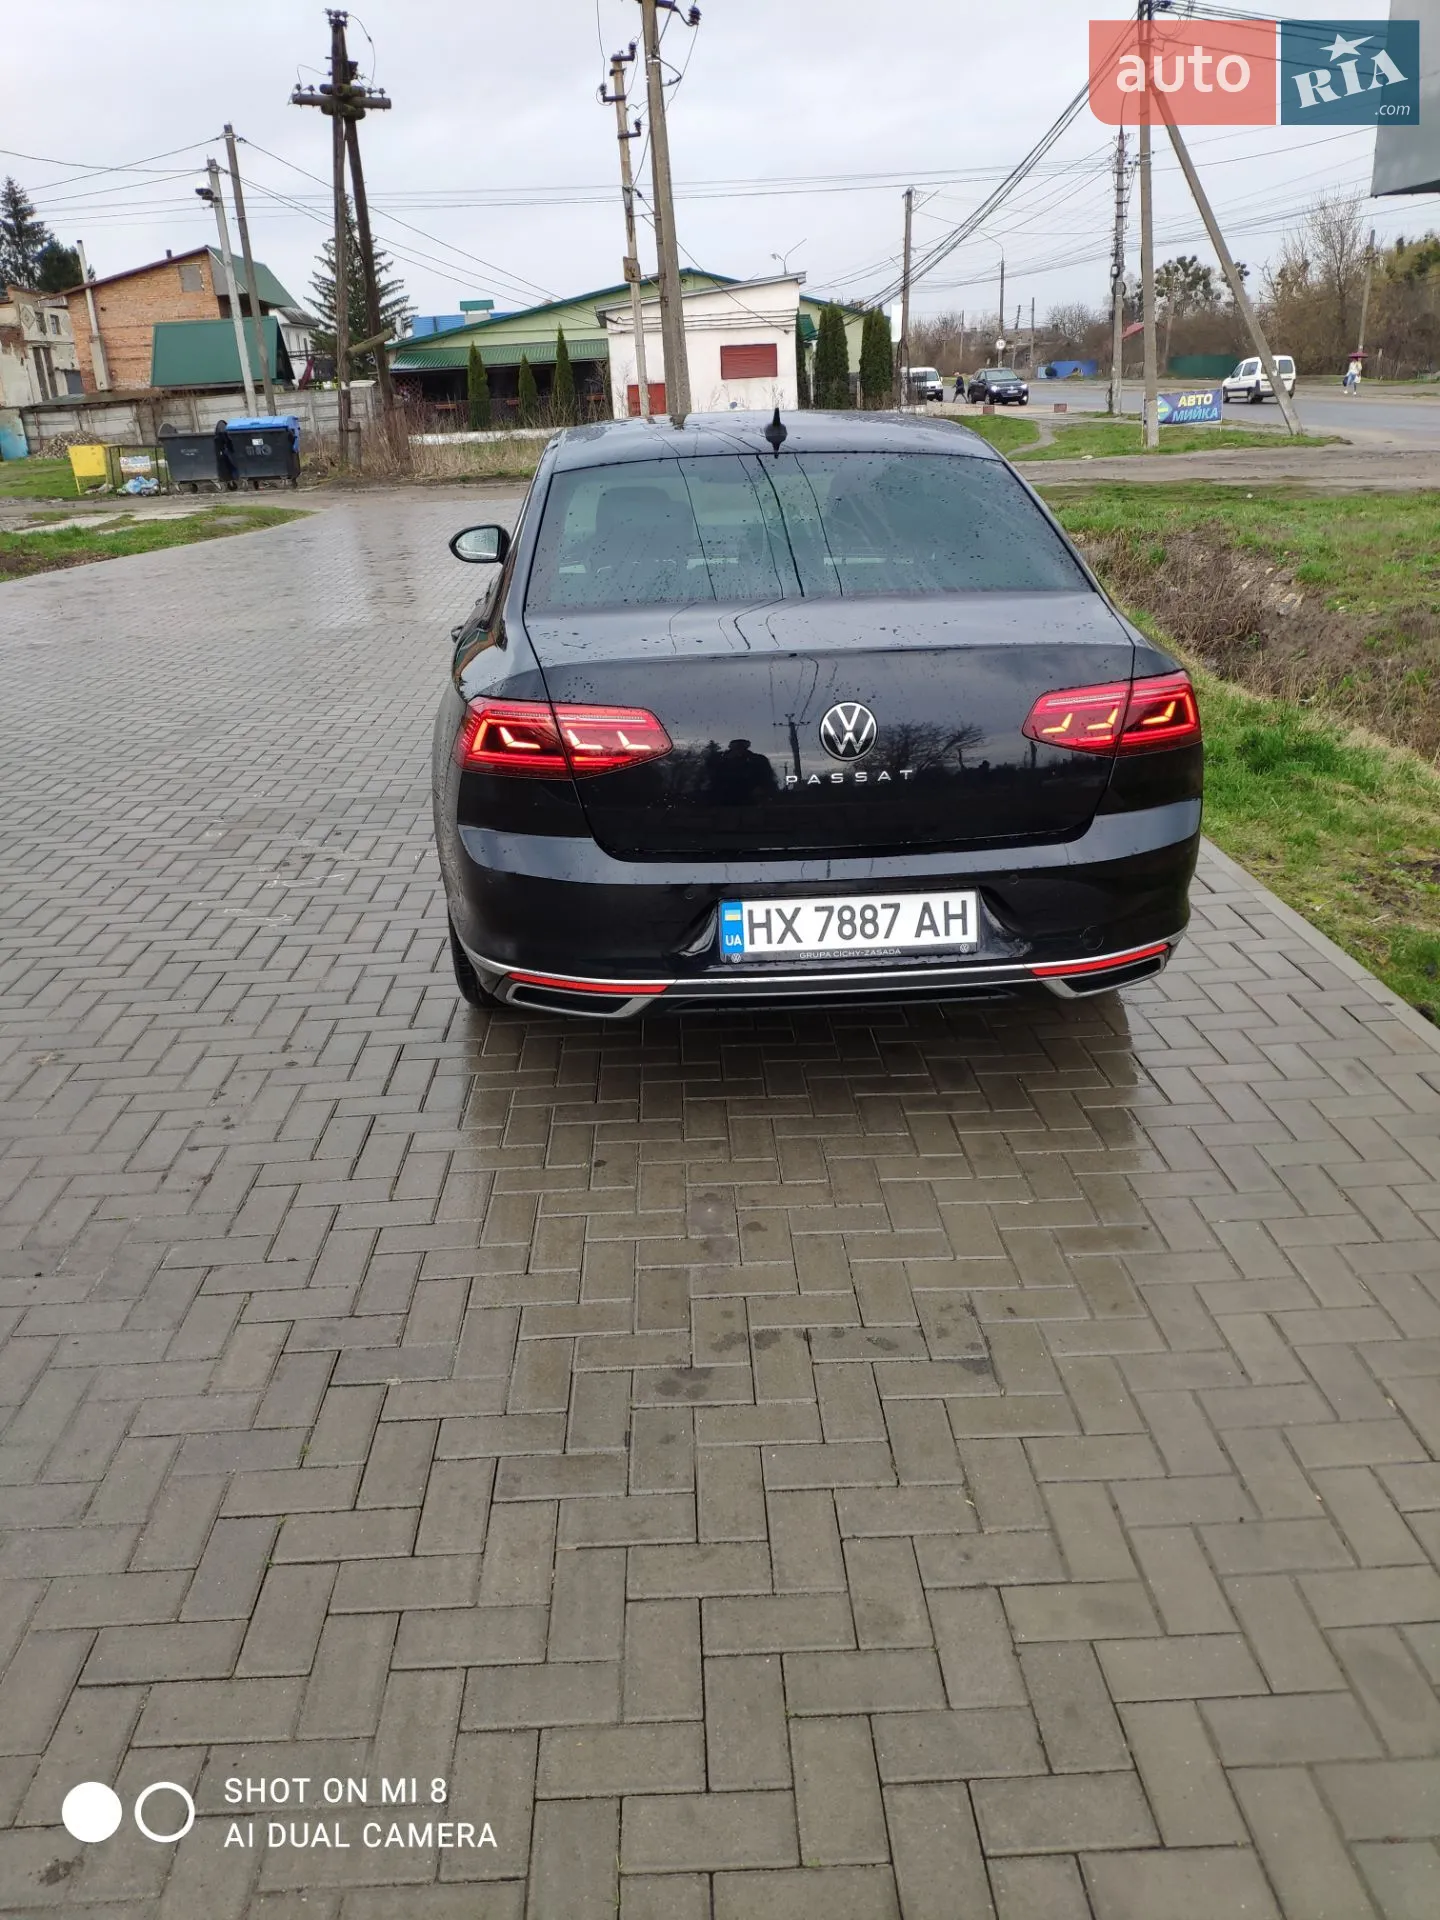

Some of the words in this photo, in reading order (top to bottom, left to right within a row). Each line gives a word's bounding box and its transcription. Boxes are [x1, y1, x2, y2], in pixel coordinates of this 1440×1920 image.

[1178, 393, 1213, 407] АВТО
[1172, 406, 1218, 422] МИЙКА
[785, 769, 913, 786] PASSAT
[747, 907, 803, 945] HX
[814, 902, 901, 943] 7887
[914, 899, 968, 937] AH
[725, 934, 743, 947] UA
[799, 951, 832, 959] GRUPA
[833, 947, 902, 957] CICHY-ZASADA
